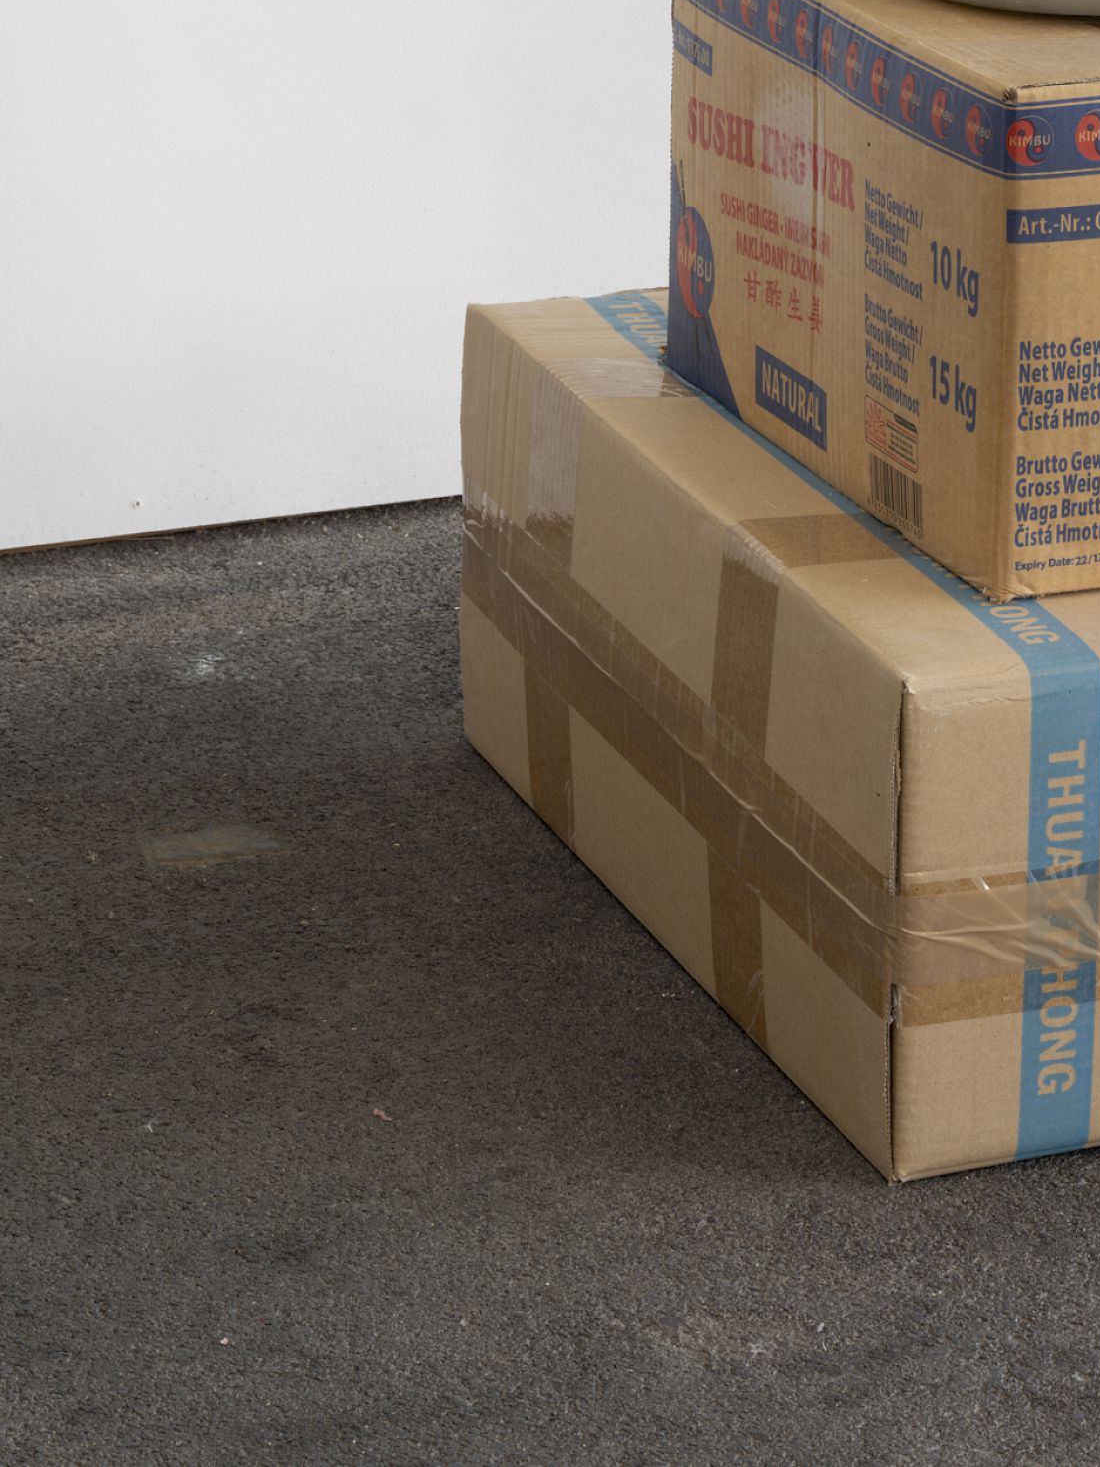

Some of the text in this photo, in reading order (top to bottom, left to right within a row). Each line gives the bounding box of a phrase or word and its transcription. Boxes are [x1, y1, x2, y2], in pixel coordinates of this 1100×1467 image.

[688, 96, 755, 168] SUSHI
[1008, 134, 1051, 147] KIMBU
[865, 178, 885, 209] Netto
[720, 192, 746, 223] SUSHI
[865, 202, 878, 224] Net
[1018, 213, 1091, 235] Art.-Nr.:
[677, 244, 713, 283] KIMBU
[930, 241, 980, 317] 10 kg
[1019, 341, 1067, 361] Netto
[1019, 363, 1049, 383] Net
[762, 360, 821, 433] NATURAL
[929, 356, 977, 432] 15 kg
[1018, 386, 1064, 410] Waga
[1017, 407, 1058, 432] Čistá
[1016, 455, 1068, 476] Brutto
[1015, 478, 1060, 498] Gross
[1015, 501, 1057, 525] Waga
[1014, 524, 1052, 547] Čistá
[1015, 559, 1047, 572] Expiry
[1049, 556, 1075, 568] Date:
[1037, 739, 1086, 1097] THUA HONG
